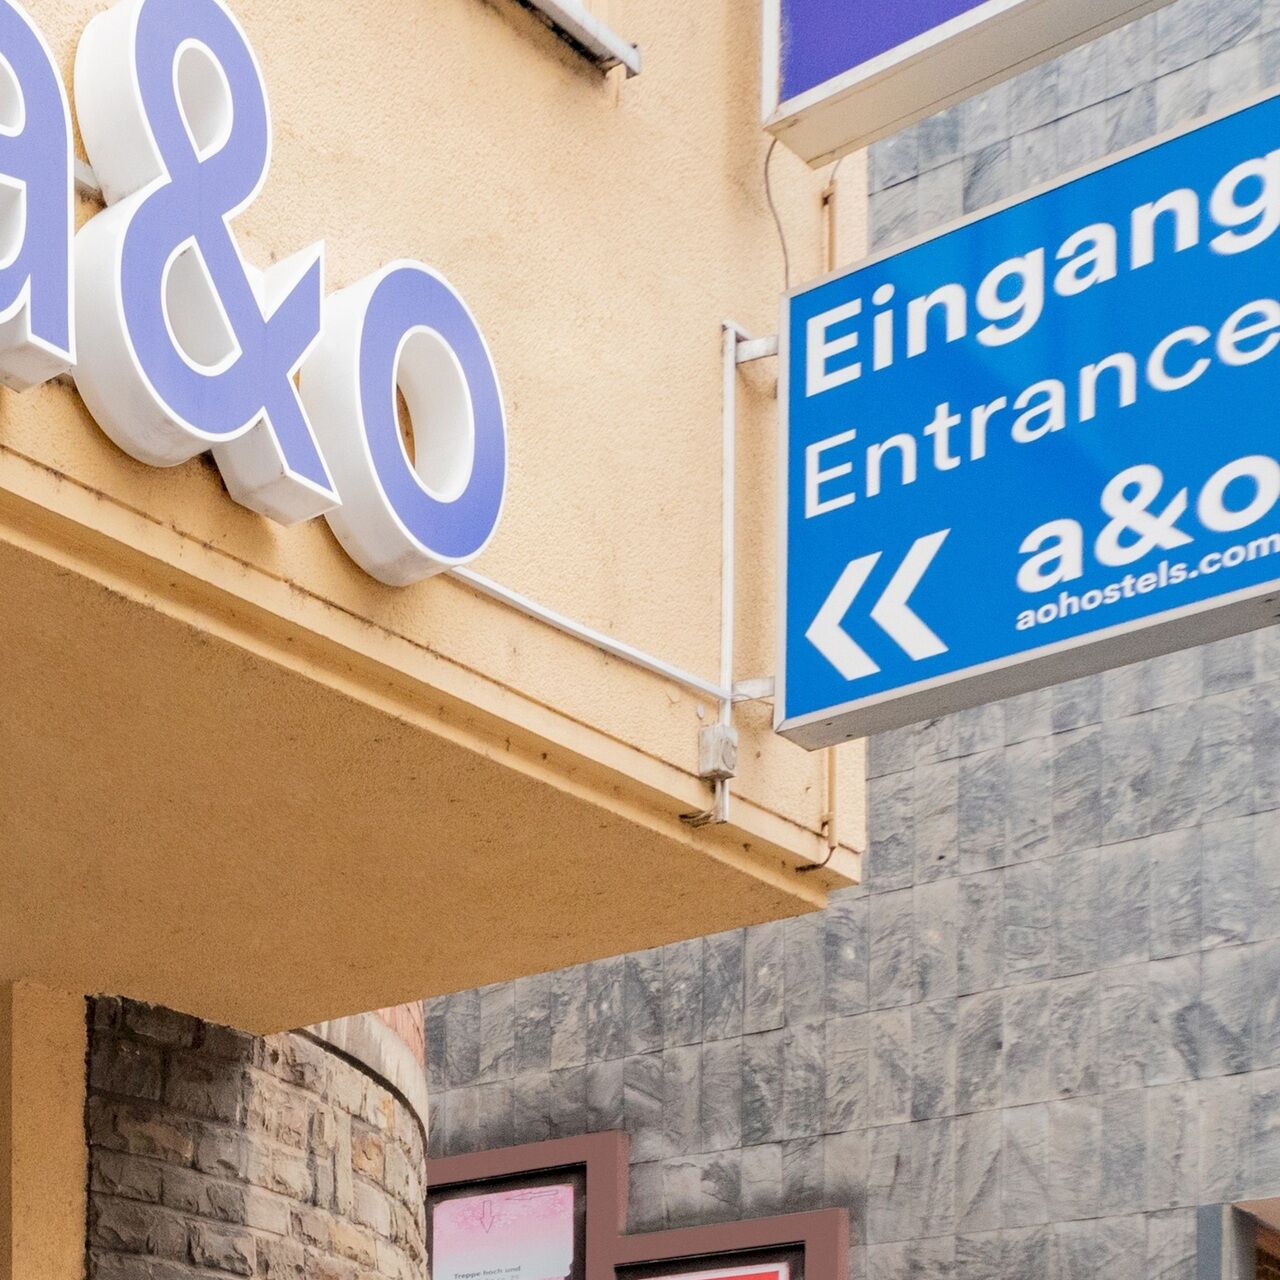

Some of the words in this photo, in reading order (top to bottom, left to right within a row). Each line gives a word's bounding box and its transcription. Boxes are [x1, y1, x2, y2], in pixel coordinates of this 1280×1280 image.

[804, 149, 1280, 398] Eingang
[804, 298, 1280, 519] Entrance
[1015, 532, 1280, 631] aohostels.com
[1016, 454, 1280, 593] a&o
[454, 1271, 481, 1280] Treppe
[482, 1267, 503, 1276] hoch
[504, 1265, 521, 1274] und
